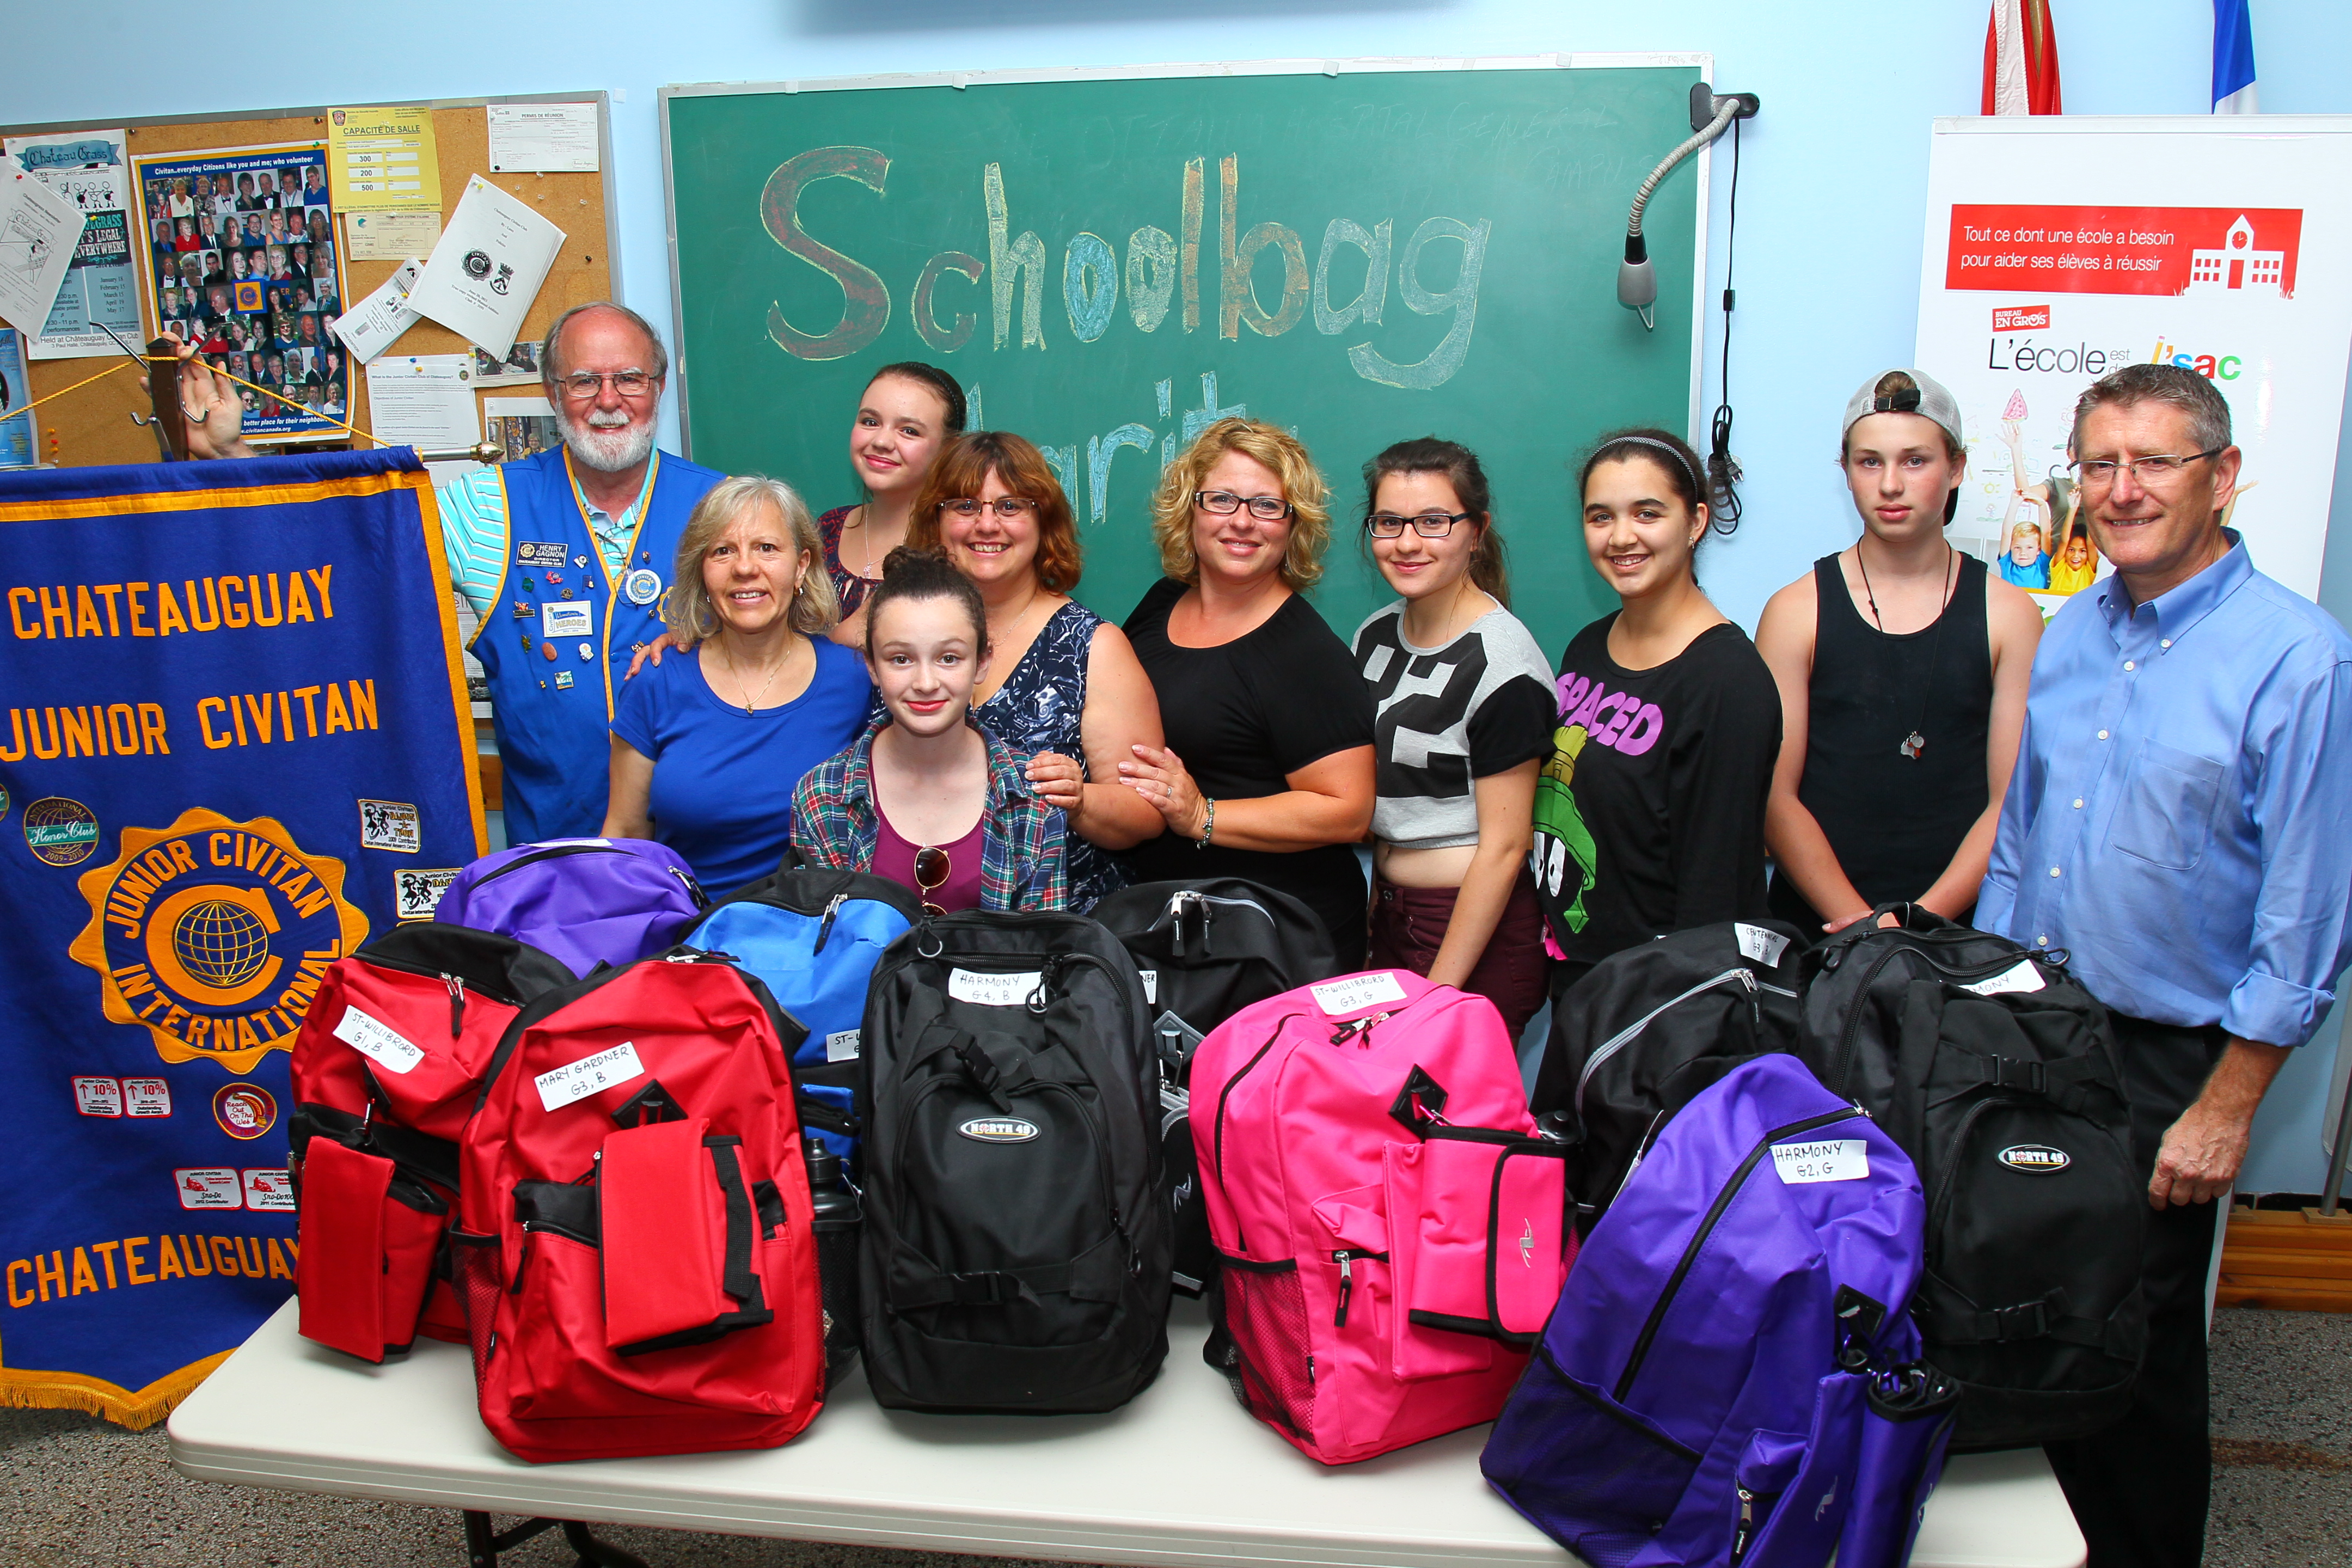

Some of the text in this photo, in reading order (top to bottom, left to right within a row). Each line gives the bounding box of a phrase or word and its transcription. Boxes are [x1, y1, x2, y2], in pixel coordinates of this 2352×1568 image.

[344, 125, 383, 134] CAPACITÉ
[29, 145, 107, 166] Chateau Grass
[238, 161, 248, 169] you
[95, 228, 121, 243] LEGAL
[1963, 226, 2175, 246] Tout ce dont une école a besoin
[74, 240, 126, 259] EVERYWHERE
[471, 252, 489, 265] CIVITAN
[1961, 252, 2162, 272] pour aider ses élèves à réussir
[759, 145, 1492, 391] Schoolbag
[1995, 310, 2022, 318] BUREAU
[1995, 313, 2047, 327] EN GROS
[40, 335, 56, 344] Held
[65, 334, 105, 343] Châteauguay
[1988, 337, 2130, 375] L'école est
[241, 426, 291, 434] w.civitancanada.org
[536, 550, 565, 558] GAGNON
[637, 575, 654, 584] CIVITAN
[8, 565, 334, 639] CHATEAUGUAY
[555, 619, 586, 628] HEROES
[0, 679, 378, 762] JUNIOR CIVITAN
[1556, 672, 1663, 756] SPACED
[28, 801, 87, 822] INTERNATIONAL
[29, 820, 96, 844] Honor Club
[44, 848, 84, 861] 2009-2010
[106, 832, 332, 939] JUNIOR CIVITAN
[1746, 927, 1779, 942] CENTENNIAL
[960, 974, 1020, 987] HARMONY
[1315, 976, 1385, 996] ST-WILLIBRORD
[1972, 974, 2010, 993] MONY
[112, 939, 340, 1051] INTERNATIONAL
[1003, 990, 1010, 1001] B
[1364, 991, 1373, 1000] G
[351, 1012, 418, 1058] ST-WILLIBRORD
[371, 1040, 383, 1052] B
[539, 1046, 630, 1089] MARY GARDNER
[596, 1071, 607, 1084] B
[93, 1083, 117, 1095] 10%
[142, 1083, 166, 1095] 10%
[971, 1123, 1031, 1134] NORTH 49
[1775, 1141, 1844, 1162] HARMONY
[2007, 1150, 2065, 1163] NORTH 49
[1822, 1163, 1834, 1175] G
